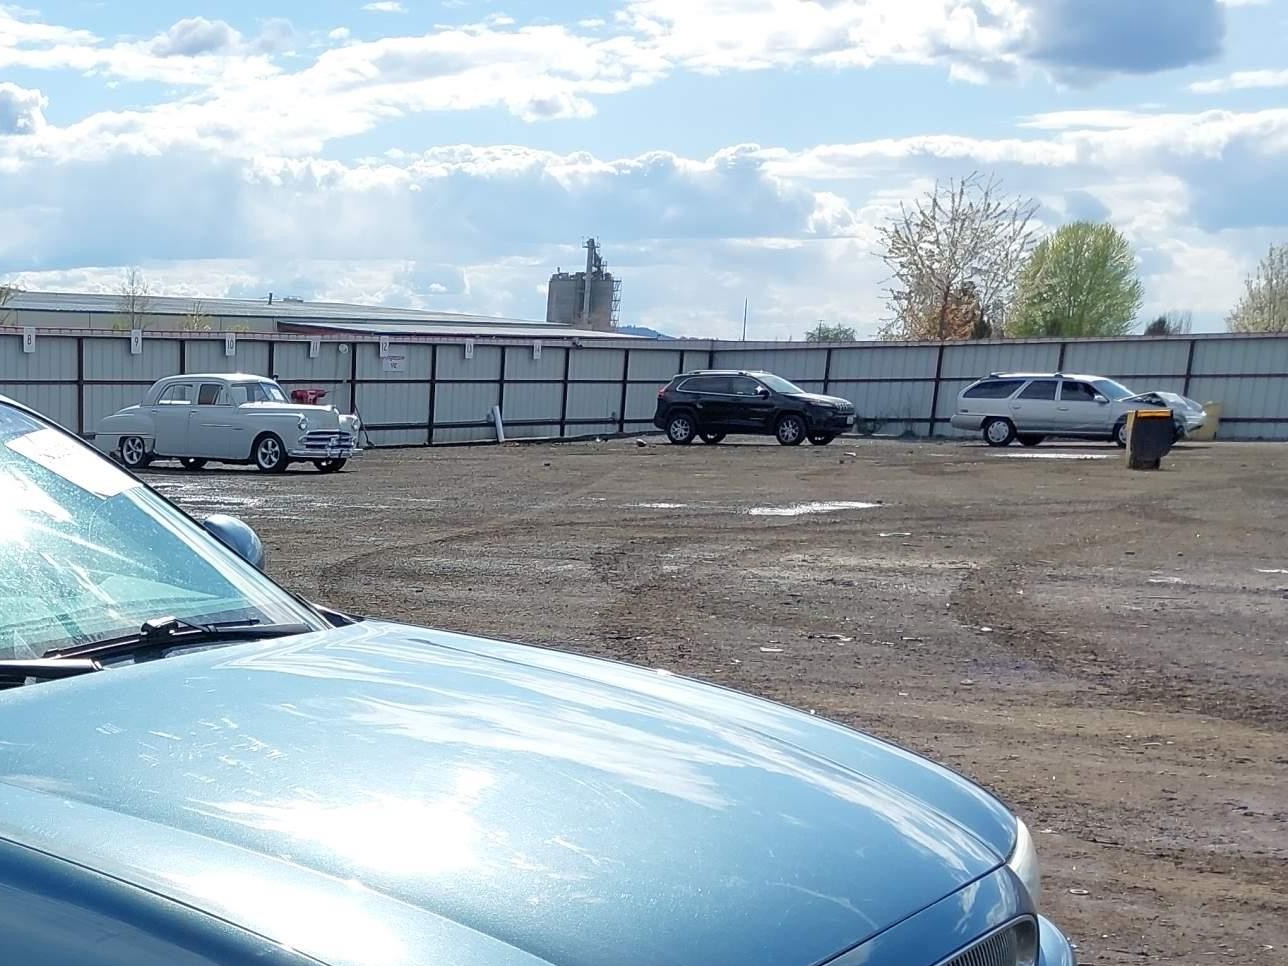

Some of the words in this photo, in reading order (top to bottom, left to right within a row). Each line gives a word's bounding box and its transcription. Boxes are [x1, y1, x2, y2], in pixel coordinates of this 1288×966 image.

[27, 334, 32, 345] 8
[134, 337, 139, 347] 9
[227, 337, 234, 350] 10
[312, 340, 318, 352] 11
[381, 341, 388, 351] 12
